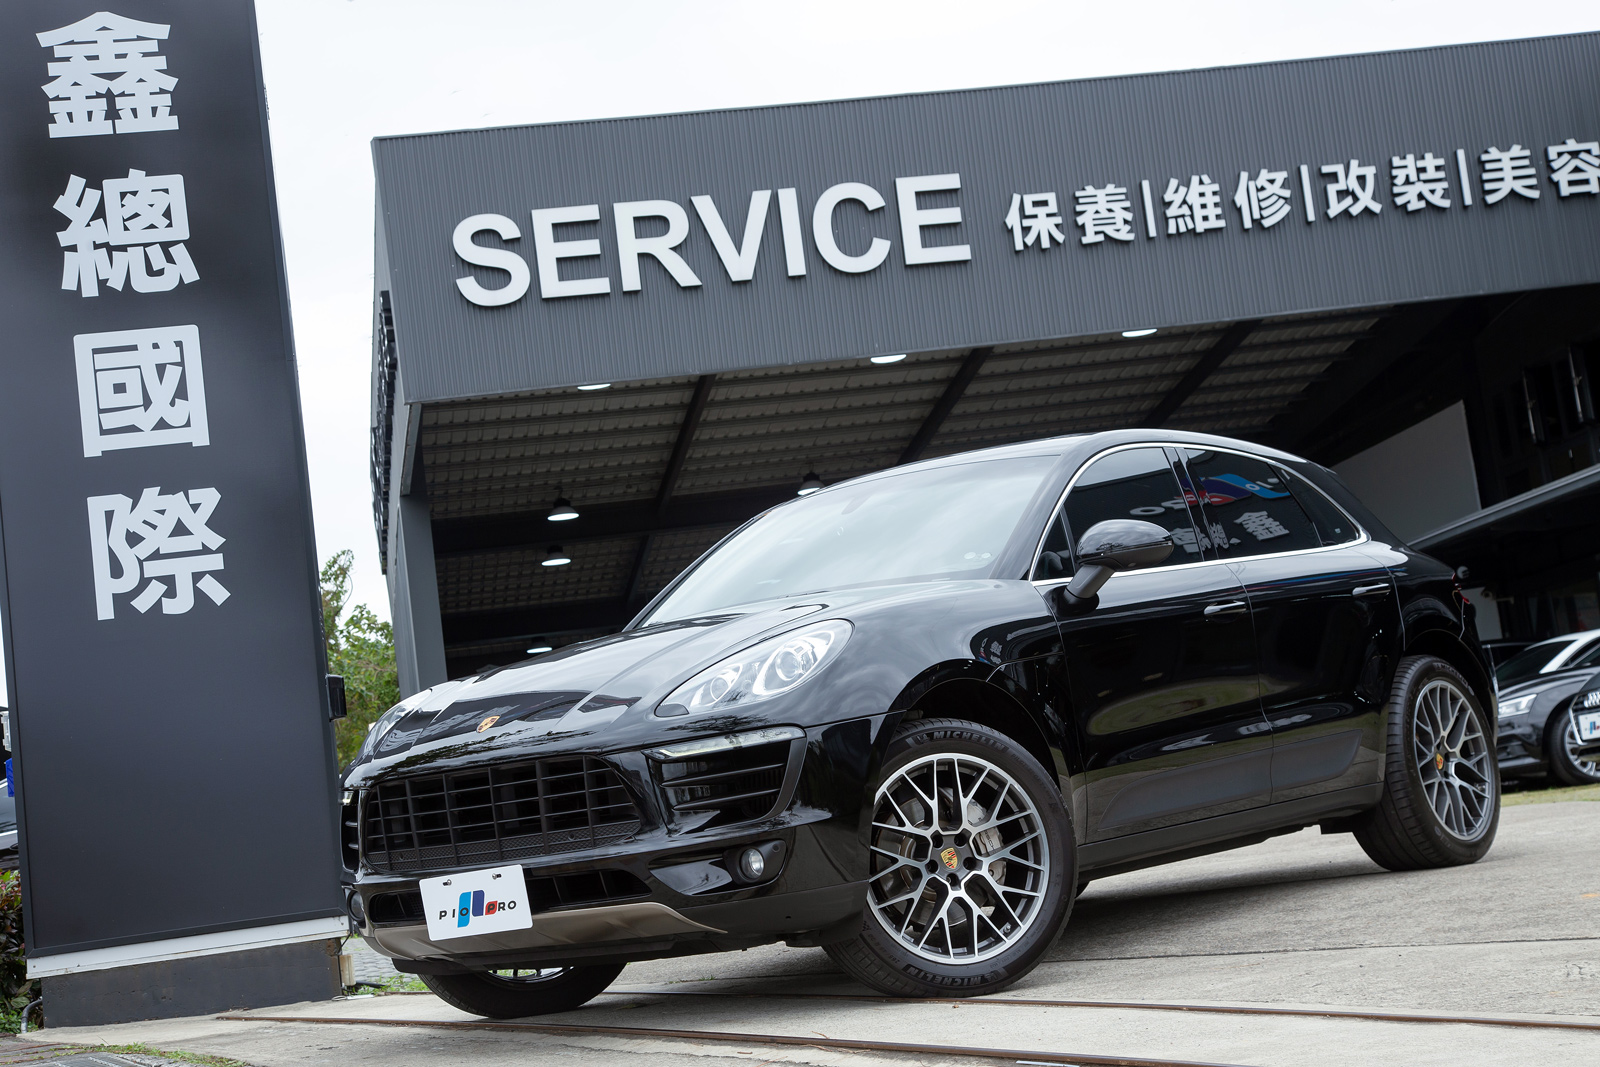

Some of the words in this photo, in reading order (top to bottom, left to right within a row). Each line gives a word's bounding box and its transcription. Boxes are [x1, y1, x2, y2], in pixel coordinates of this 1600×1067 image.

[452, 173, 972, 307] SERVICE
[35, 11, 231, 620] 鑫總國際
[933, 731, 1005, 753] MICHELIN
[906, 965, 982, 986] MICHELIN
